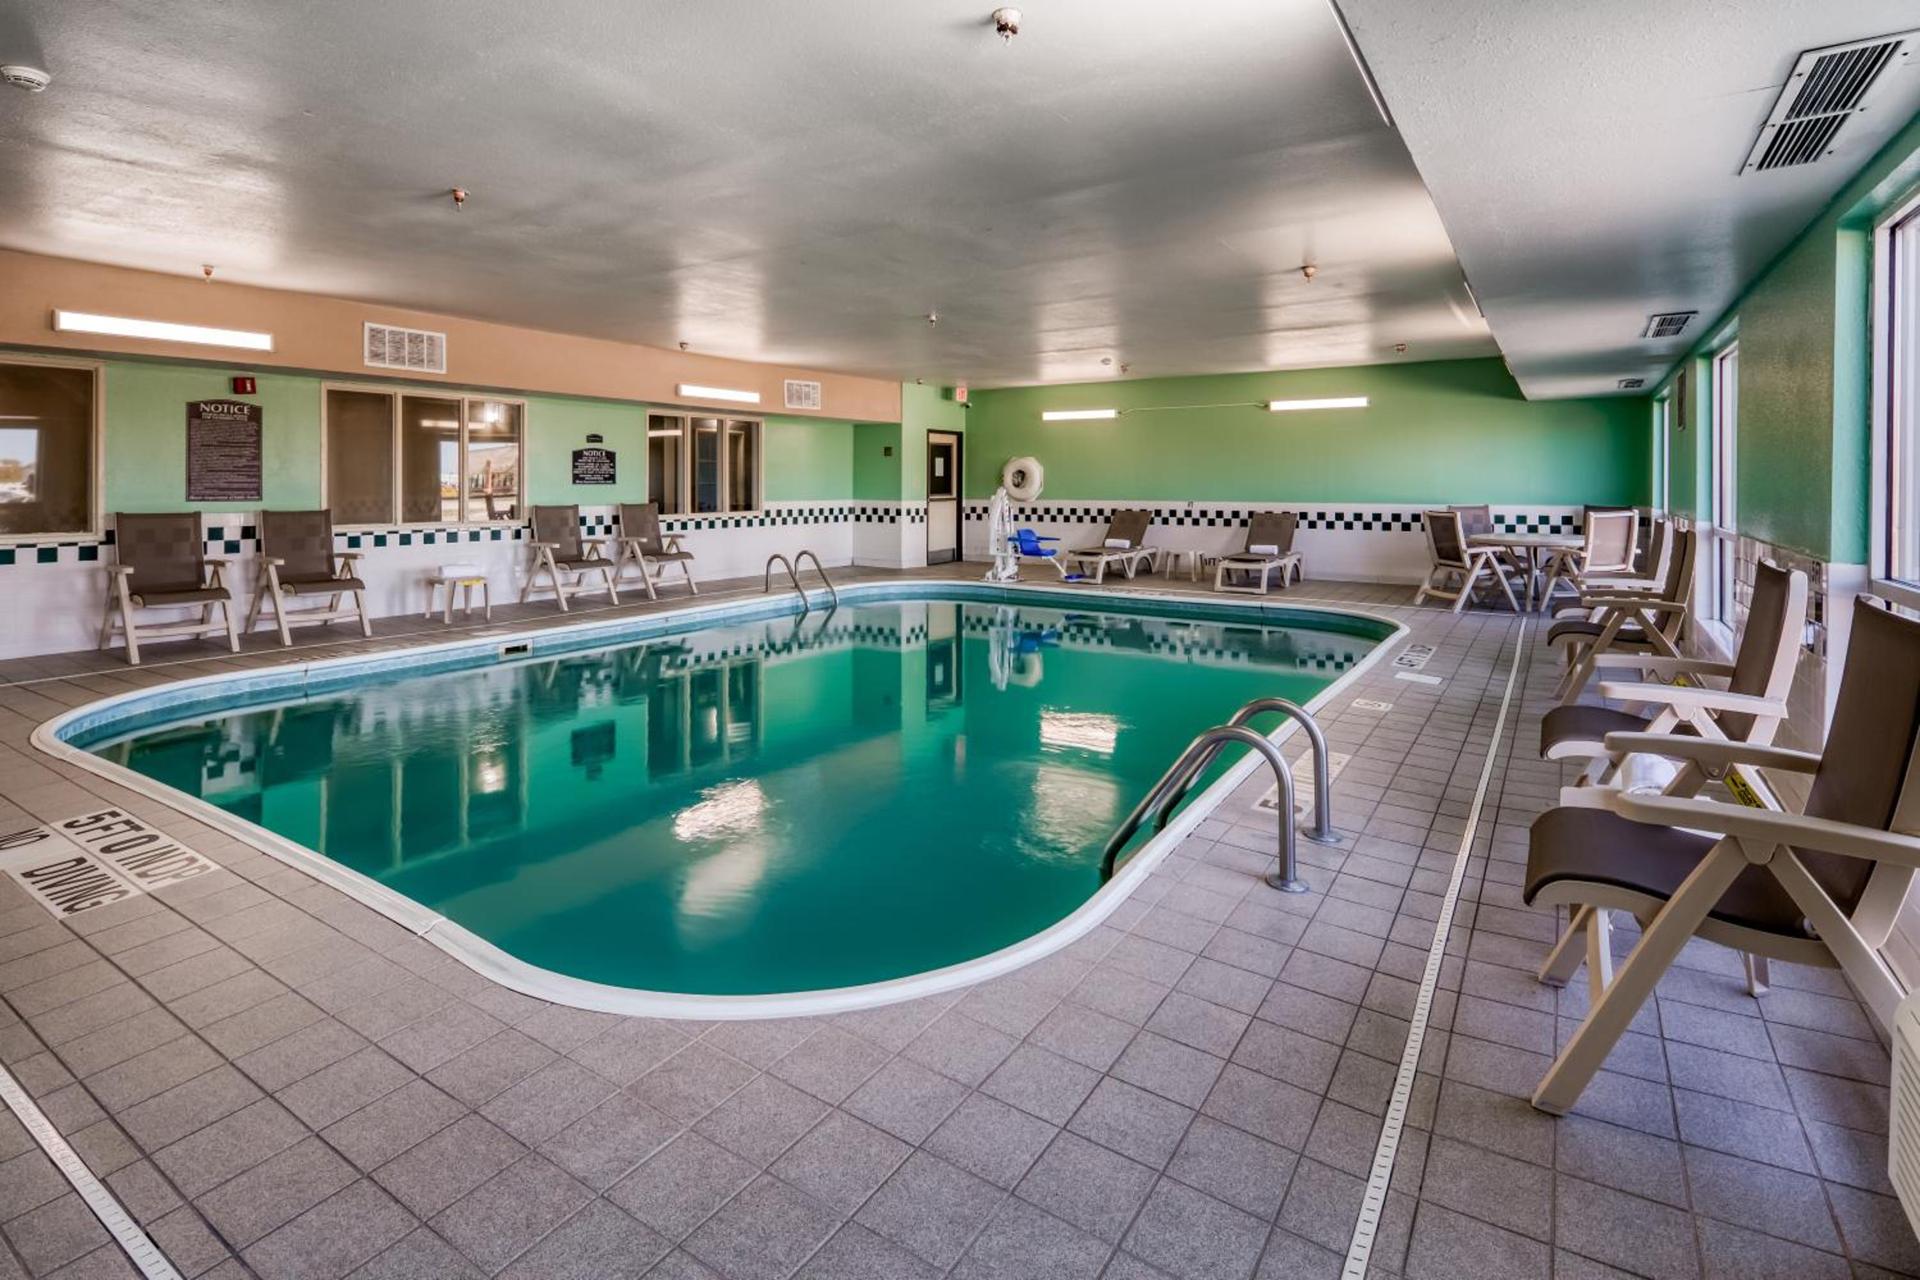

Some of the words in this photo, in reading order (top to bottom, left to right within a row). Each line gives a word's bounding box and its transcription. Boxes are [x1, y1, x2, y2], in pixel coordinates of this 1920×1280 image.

[200, 402, 251, 414] NOTICE
[63, 810, 121, 829] 5
[74, 819, 146, 843] FT
[20, 856, 131, 915] DIVING
